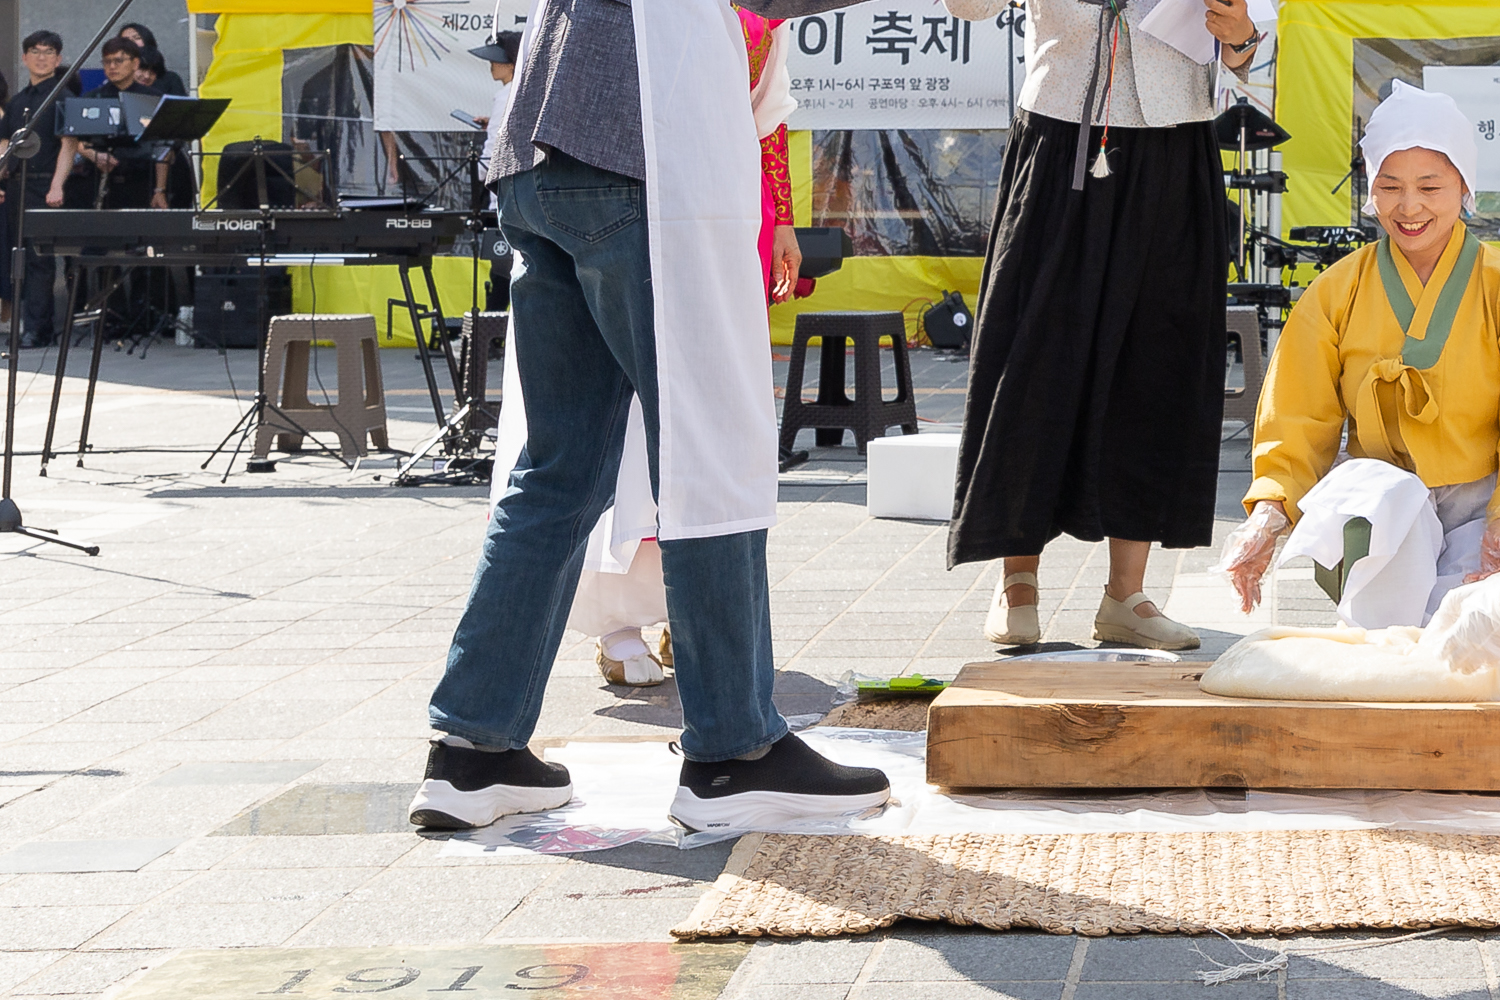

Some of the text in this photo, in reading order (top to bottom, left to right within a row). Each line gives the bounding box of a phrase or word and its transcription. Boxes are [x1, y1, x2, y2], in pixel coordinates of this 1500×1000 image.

[866, 10, 971, 66] 축제
[790, 78, 816, 91] 오후
[867, 78, 906, 91] 구포역
[909, 78, 922, 91] 앞
[925, 78, 950, 91] 광장
[917, 98, 938, 109] 오후
[257, 962, 592, 996] 1919
